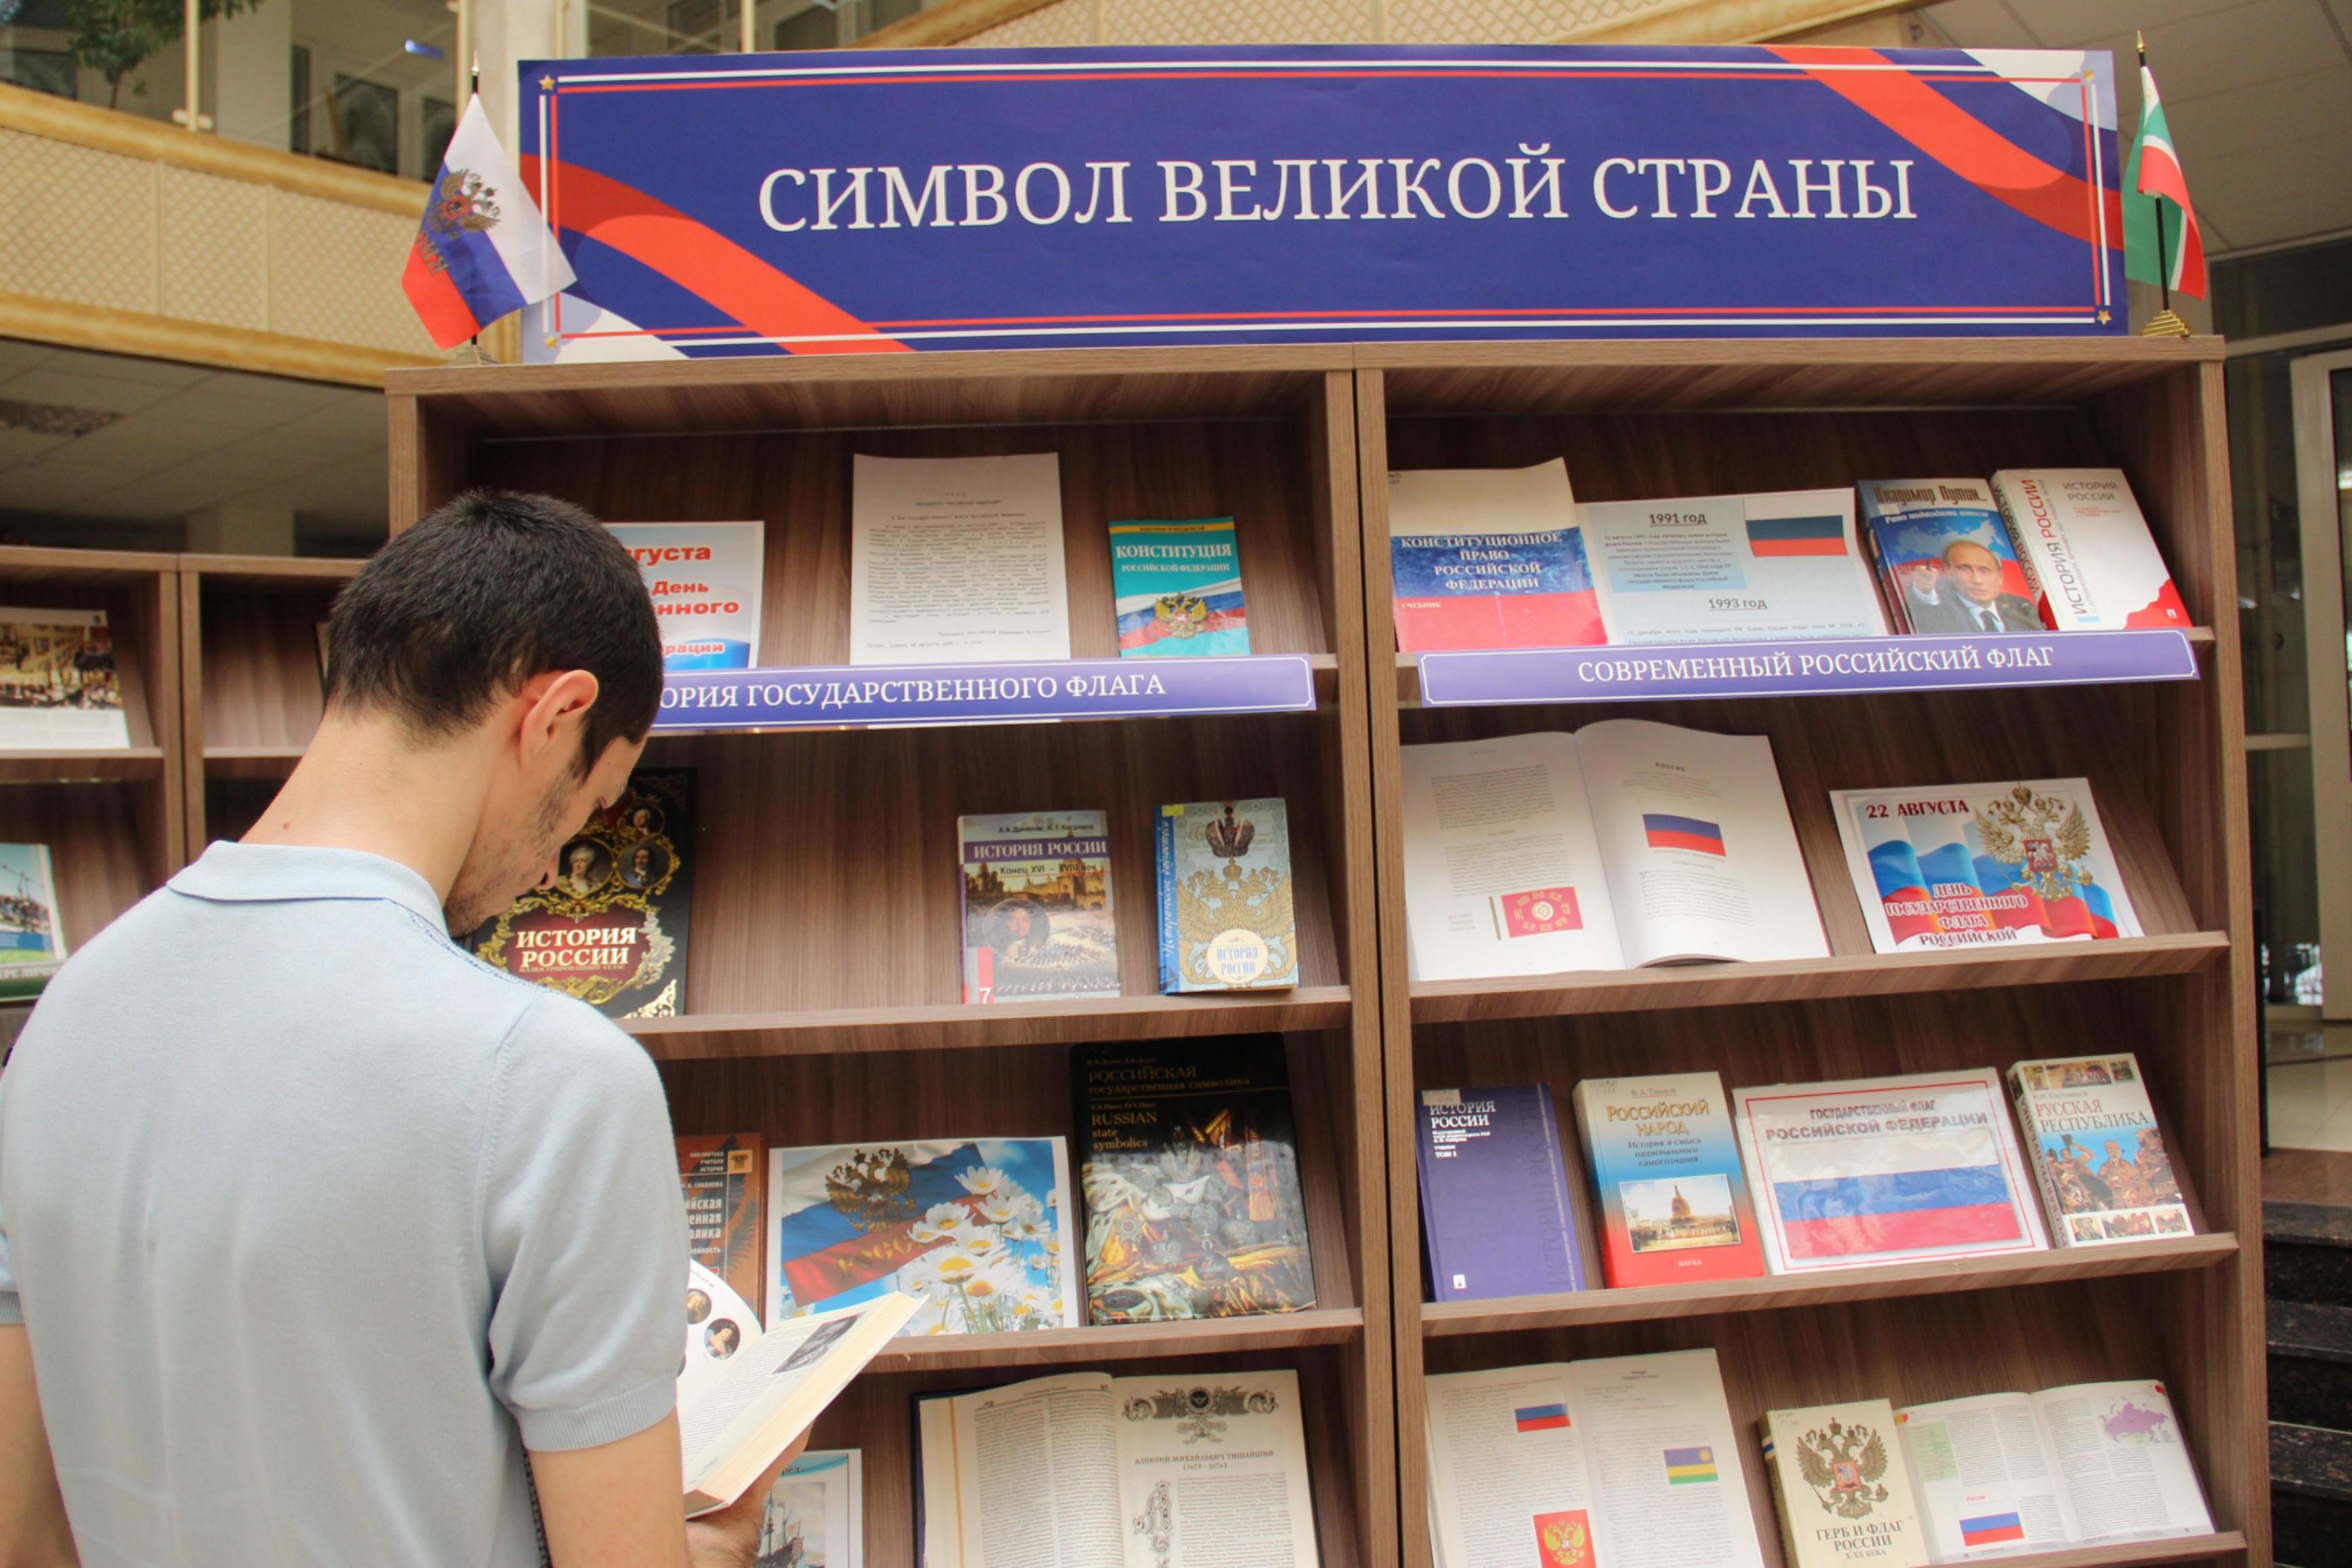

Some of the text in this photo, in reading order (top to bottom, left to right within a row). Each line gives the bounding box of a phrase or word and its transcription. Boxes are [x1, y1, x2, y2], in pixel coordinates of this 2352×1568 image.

[758, 142, 1917, 234] СИМВОЛ ВЕЛИКОЙ СТРАНЫ
[1873, 486, 1936, 505] Владимир
[1649, 513, 1707, 525] 1991 год
[1885, 515, 1907, 523] Рано
[1401, 532, 1561, 548] КОНСТИТУЦИОННОЕ
[1994, 484, 2040, 594] ИСТОРИЯ РОССИИ
[2020, 479, 2087, 614] ИСТОРИЯ РОССИИ
[627, 546, 711, 565] густа
[1115, 543, 1232, 559] КОНСТИТУЦИЯ
[1459, 550, 1510, 561] ПРАВО
[1121, 563, 1178, 572] РОССИЙСКОЙ
[1434, 561, 1541, 576] РОССИЙСКОЙ
[652, 581, 709, 596] День
[1445, 578, 1539, 591] ФЕДЕРАЦИИ
[656, 601, 739, 615] нного
[1708, 599, 1768, 610] 1993 год
[664, 643, 724, 656] рации
[1578, 646, 2055, 682] СОВРЕМЕННЫЙ РОССИЙСКИЙ ФЛАГ
[660, 674, 1167, 709] ОРИЯ ГОСУДАРСТВЕННОГО ФЛАГА
[1866, 800, 1968, 818] 22 АВГУСТА
[974, 840, 1107, 859] ИСТОРИЯ РОССИИ
[1000, 867, 1028, 876] Конец
[1934, 883, 1971, 898] ДЕНЬ
[1885, 895, 2028, 915] ГОСУДАРСТВЕННОГО
[1939, 914, 1988, 929] ФЛАГА
[516, 927, 637, 948] ИСТОРИЯ
[1919, 927, 2017, 945] РОССИЙСКОЙ
[520, 947, 629, 968] РОССИИ
[1216, 946, 1258, 962] ИСТОРИЯ
[1220, 961, 1255, 975] РОССИИ
[979, 988, 991, 1004] 7
[1088, 1065, 1197, 1083] РОССИЙСКАЯ
[1430, 1100, 1496, 1116] ИСТОРИЯ
[1606, 1098, 1710, 1122] РОССИЙСКИЙ
[1810, 1100, 1937, 1120] ГОСУДАРСТВЕННЫЙ ФЛАГ
[2035, 1099, 2104, 1117] РУССКАЯ
[1091, 1111, 1157, 1127] RUSSIAN
[1431, 1114, 1490, 1128] РОССИИ
[1766, 1112, 1988, 1141] РОССИЙСКОЙ ФЕДЕРАЦИИ
[2039, 1110, 2150, 1134] РЕСПУБЛИКА
[1092, 1127, 1118, 1138] state
[1636, 1120, 1690, 1137] НАРОД
[1093, 1136, 1149, 1151] symbolics
[1628, 1140, 1664, 1149] История
[1635, 1147, 1698, 1157] национального
[1639, 1157, 1698, 1167] самосознания
[684, 1197, 722, 1210] ийская
[689, 1213, 722, 1225] енная
[690, 1227, 721, 1240] олика
[1816, 1520, 1903, 1541] ГЕРБ И ФЛАГ
[1833, 1534, 1892, 1552] РОССИИ
[1866, 1549, 1887, 1558] ВЕКА
